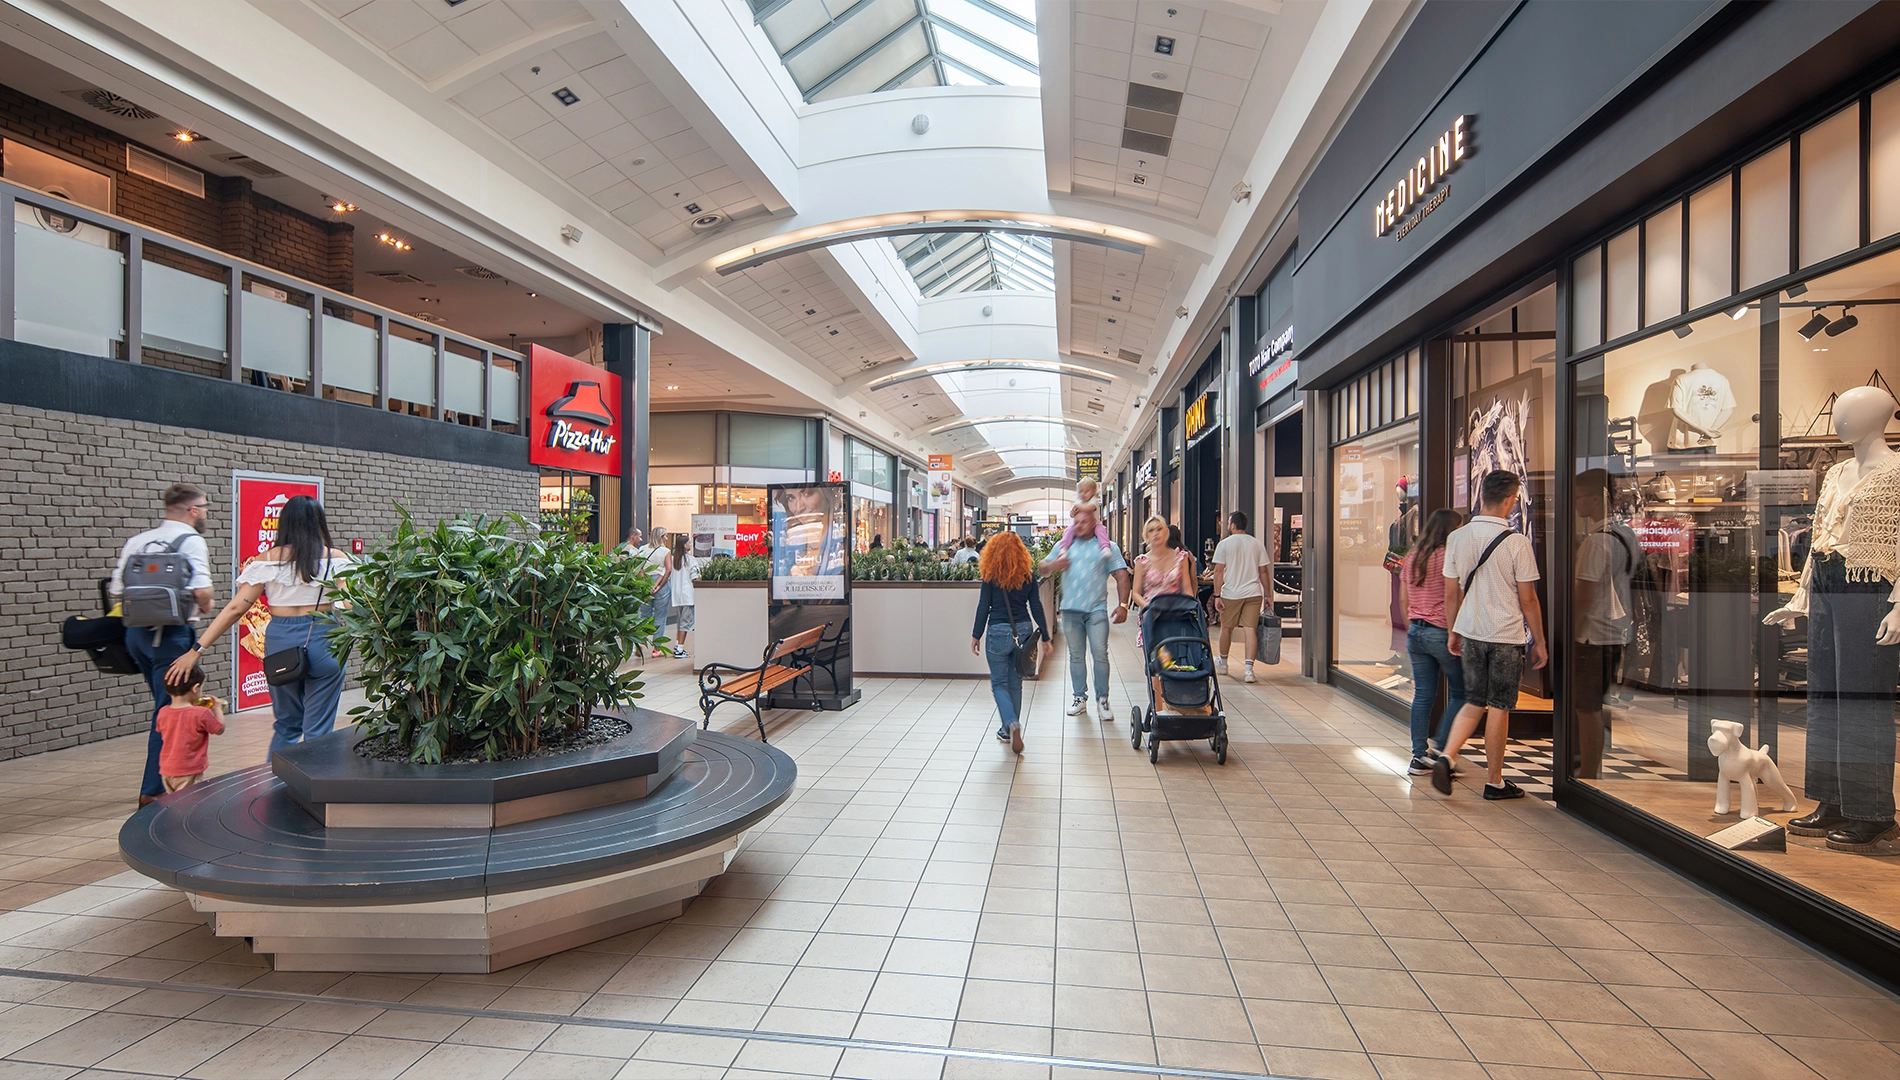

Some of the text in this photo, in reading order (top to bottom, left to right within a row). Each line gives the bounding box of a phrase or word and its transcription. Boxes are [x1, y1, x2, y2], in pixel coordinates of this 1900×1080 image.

[1376, 114, 1464, 238] MEDICINE
[1396, 184, 1450, 242] EVERYDAY THERAPY
[552, 419, 616, 455] Pizza Hut
[1079, 458, 1093, 467] 150
